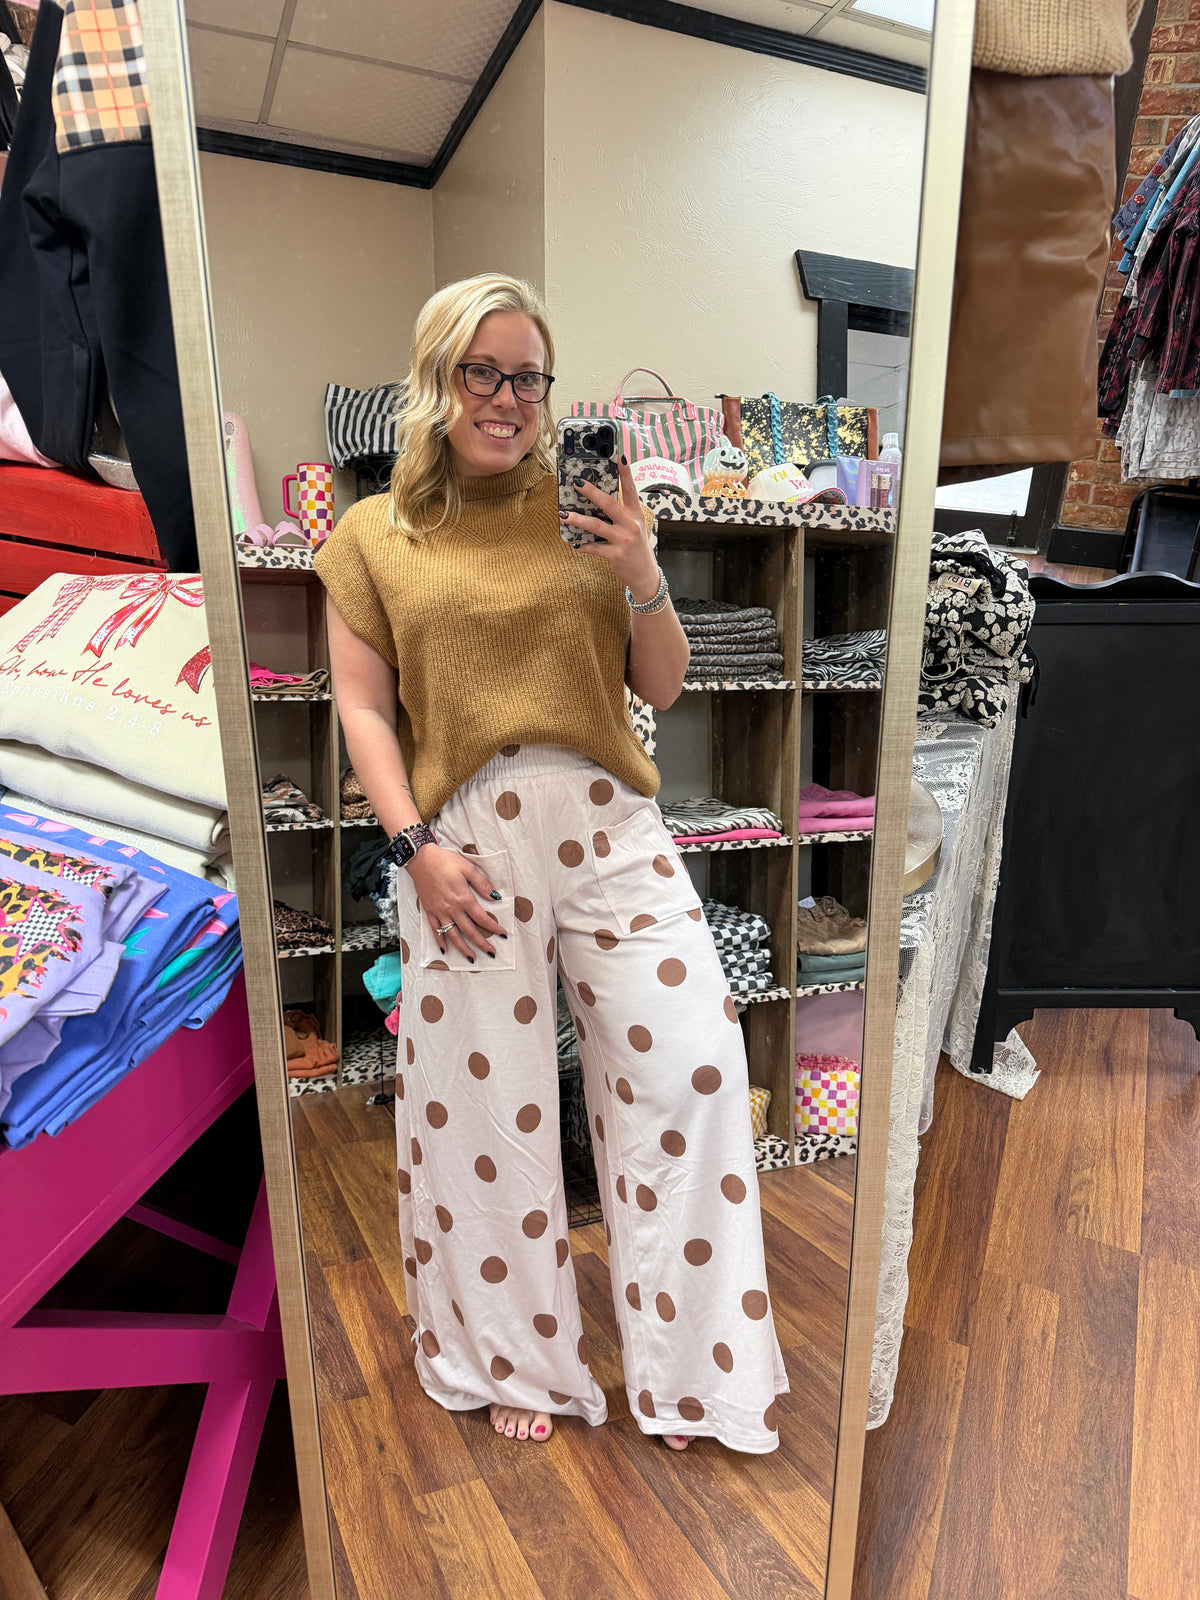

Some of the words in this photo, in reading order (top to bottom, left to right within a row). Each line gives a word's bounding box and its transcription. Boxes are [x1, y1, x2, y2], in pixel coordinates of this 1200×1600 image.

[0, 655, 26, 681] Oh,
[26, 660, 68, 678] how
[72, 660, 113, 687] He
[111, 677, 177, 715] loves
[181, 711, 212, 728] us
[0, 680, 97, 712] Ephesians
[105, 705, 163, 736] 2:4-8
